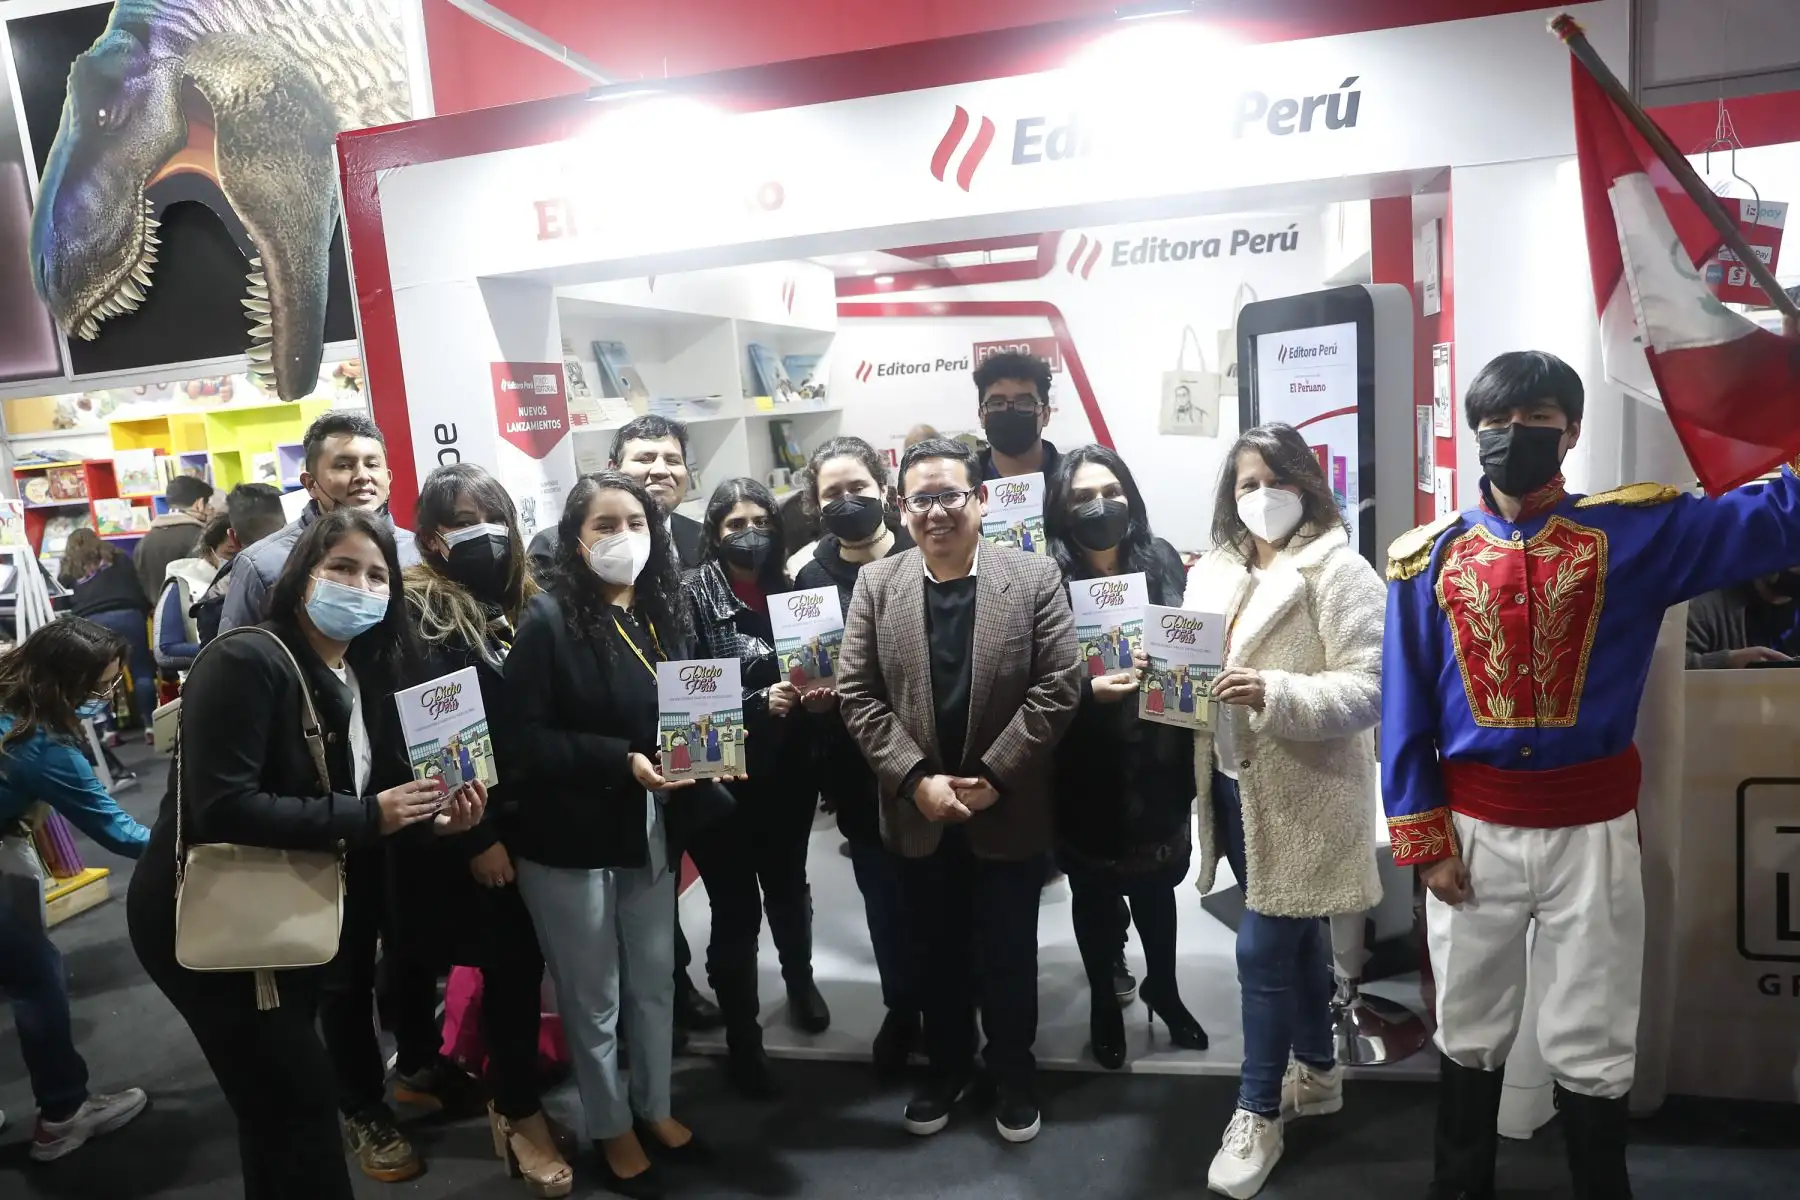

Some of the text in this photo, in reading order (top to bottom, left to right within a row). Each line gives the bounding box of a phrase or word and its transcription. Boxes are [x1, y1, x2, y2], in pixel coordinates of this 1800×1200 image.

[1232, 76, 1362, 139] Perú
[1111, 222, 1299, 267] Editora Perú
[1288, 342, 1338, 359] Editora Perú
[877, 355, 969, 377] Editora Perú
[1289, 382, 1327, 393] El Peruano
[518, 405, 548, 417] NUEVOS
[506, 419, 562, 433] LANZAMIENTOS
[995, 481, 1030, 497] Dicho
[1090, 580, 1129, 597] Dicho
[788, 592, 824, 611] Dicho
[1161, 614, 1204, 631] Dicho
[680, 664, 723, 681] Dicho
[421, 681, 462, 708] Dicho
